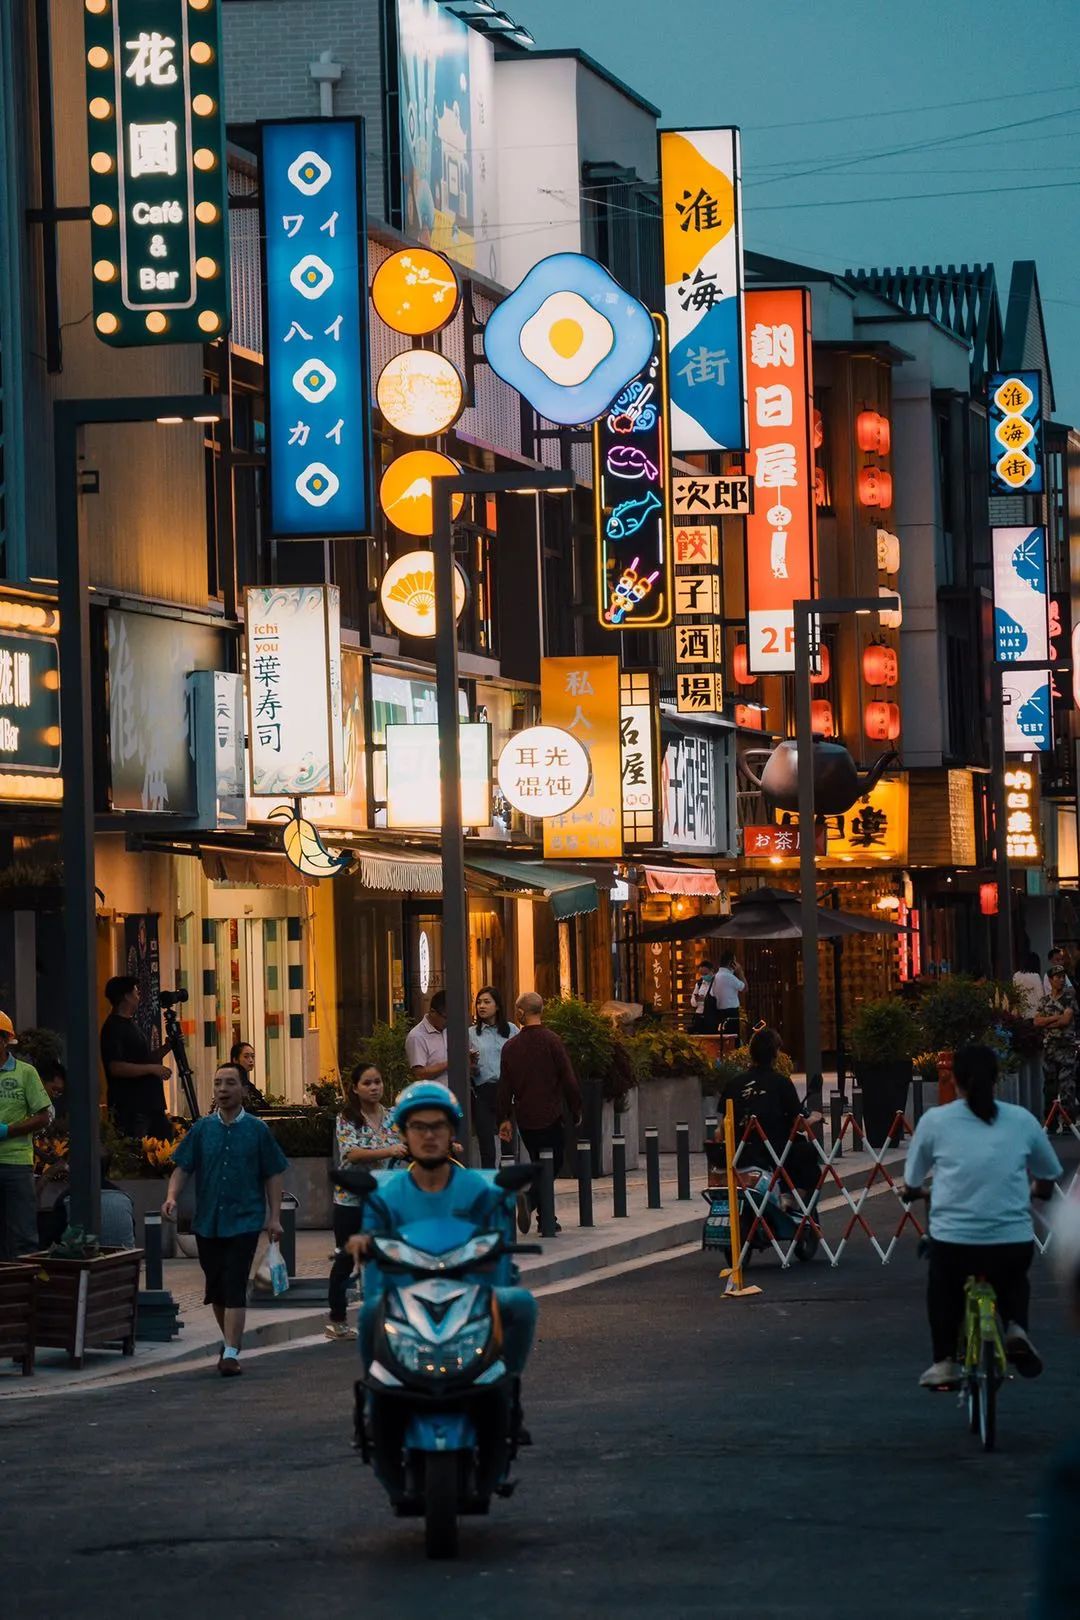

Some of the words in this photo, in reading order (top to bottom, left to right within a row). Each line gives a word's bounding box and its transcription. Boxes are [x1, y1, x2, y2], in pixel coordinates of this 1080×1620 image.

[132, 201, 182, 225] Café
[149, 235, 168, 258] &
[139, 267, 179, 291] Bar
[675, 187, 730, 387] 淮海街
[751, 323, 798, 488] 朝日屋
[1003, 387, 1027, 477] 淮海街
[674, 480, 748, 511] 次郎
[253, 623, 279, 636] ichi
[676, 530, 711, 708] 餃子酒場
[254, 642, 279, 654] you
[1000, 639, 1021, 647] HAI
[514, 746, 572, 768] 耳光
[514, 776, 574, 797] 馄饨
[755, 831, 800, 851] お茶
